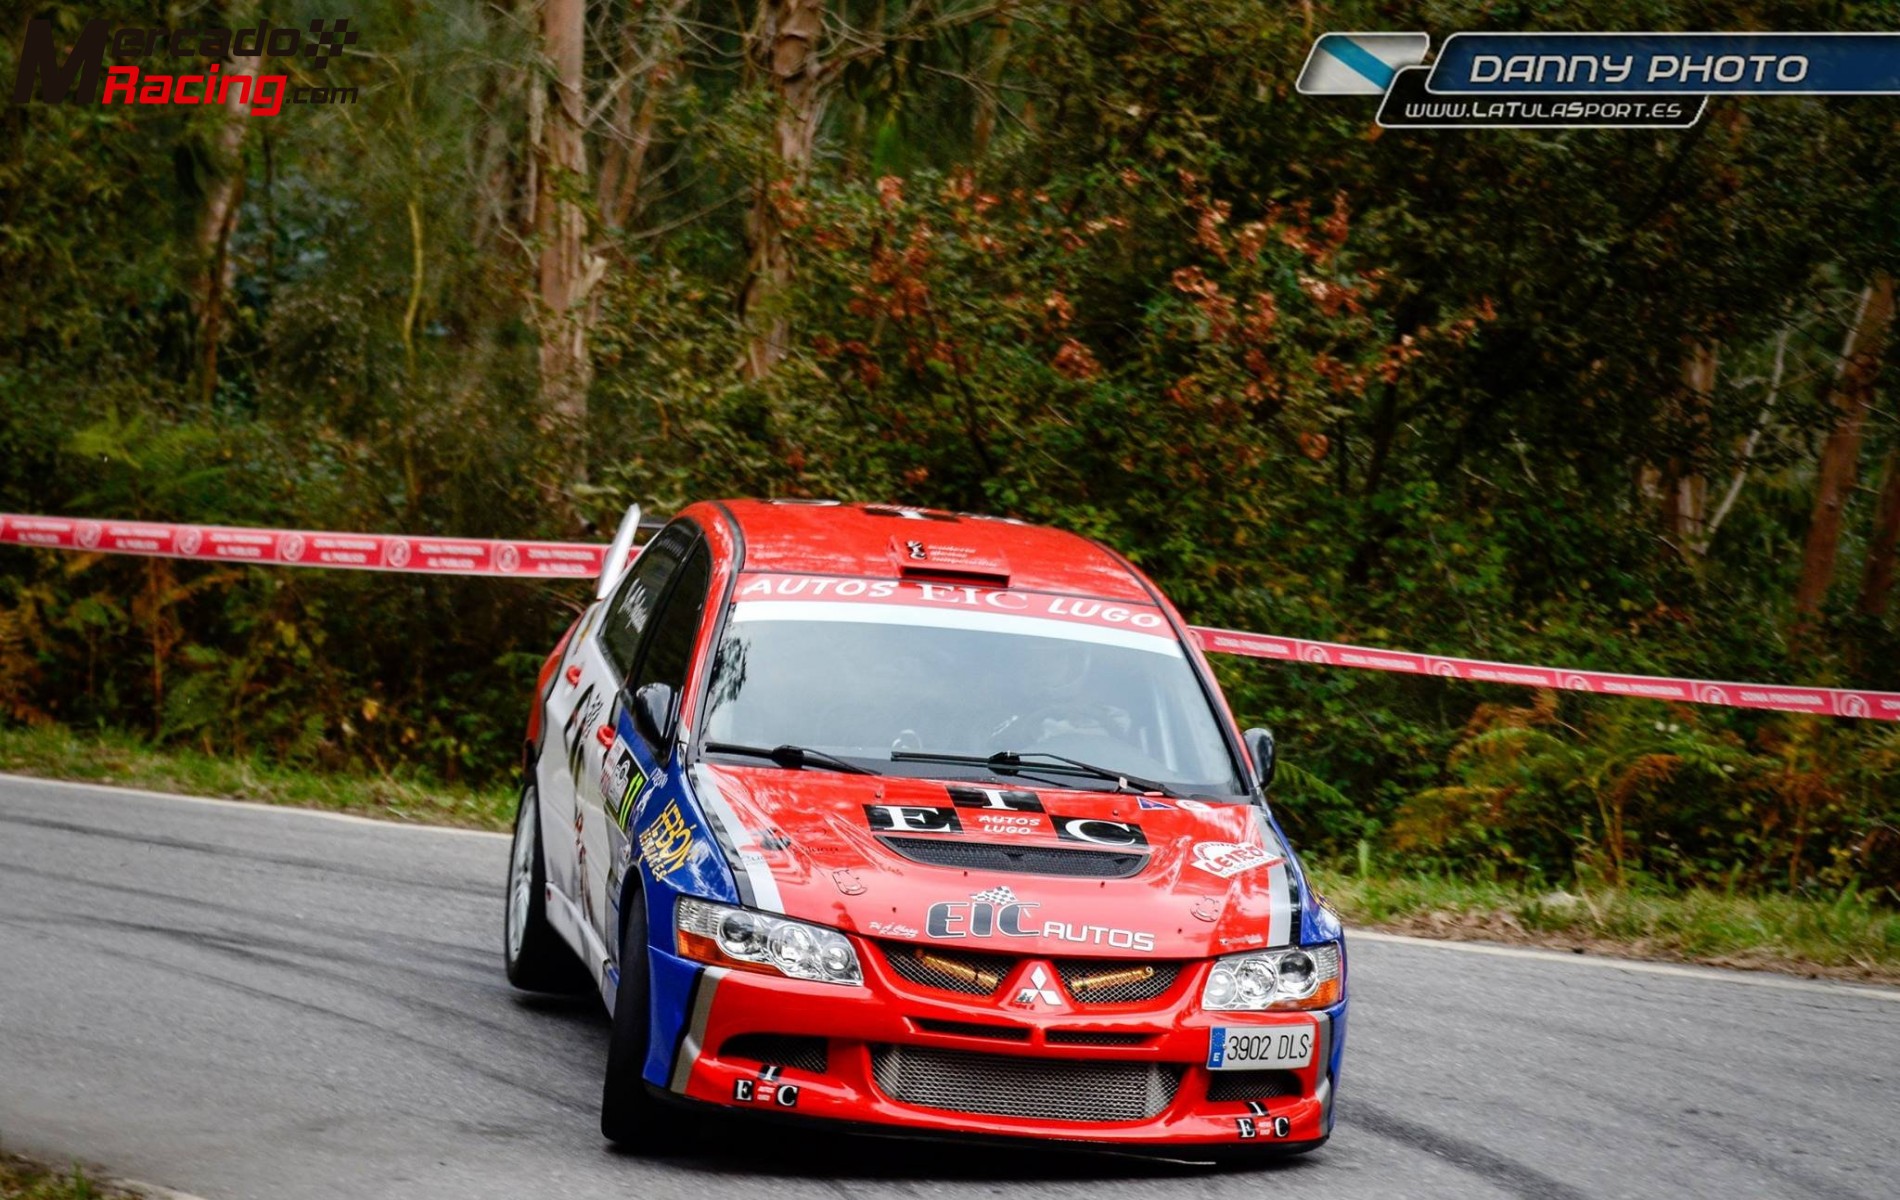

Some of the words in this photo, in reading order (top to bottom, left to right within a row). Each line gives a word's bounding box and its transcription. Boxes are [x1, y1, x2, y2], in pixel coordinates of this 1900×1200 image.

[741, 577, 899, 597] AUTOS
[916, 583, 1029, 610] EIC
[1047, 597, 1162, 628] LUGO
[978, 815, 1041, 826] AUTOS
[983, 824, 1031, 835] LUGO
[926, 901, 1040, 938] EIC
[1043, 921, 1155, 951] AUTOS
[1226, 1035, 1272, 1061] 3902
[1277, 1033, 1310, 1060] DLS
